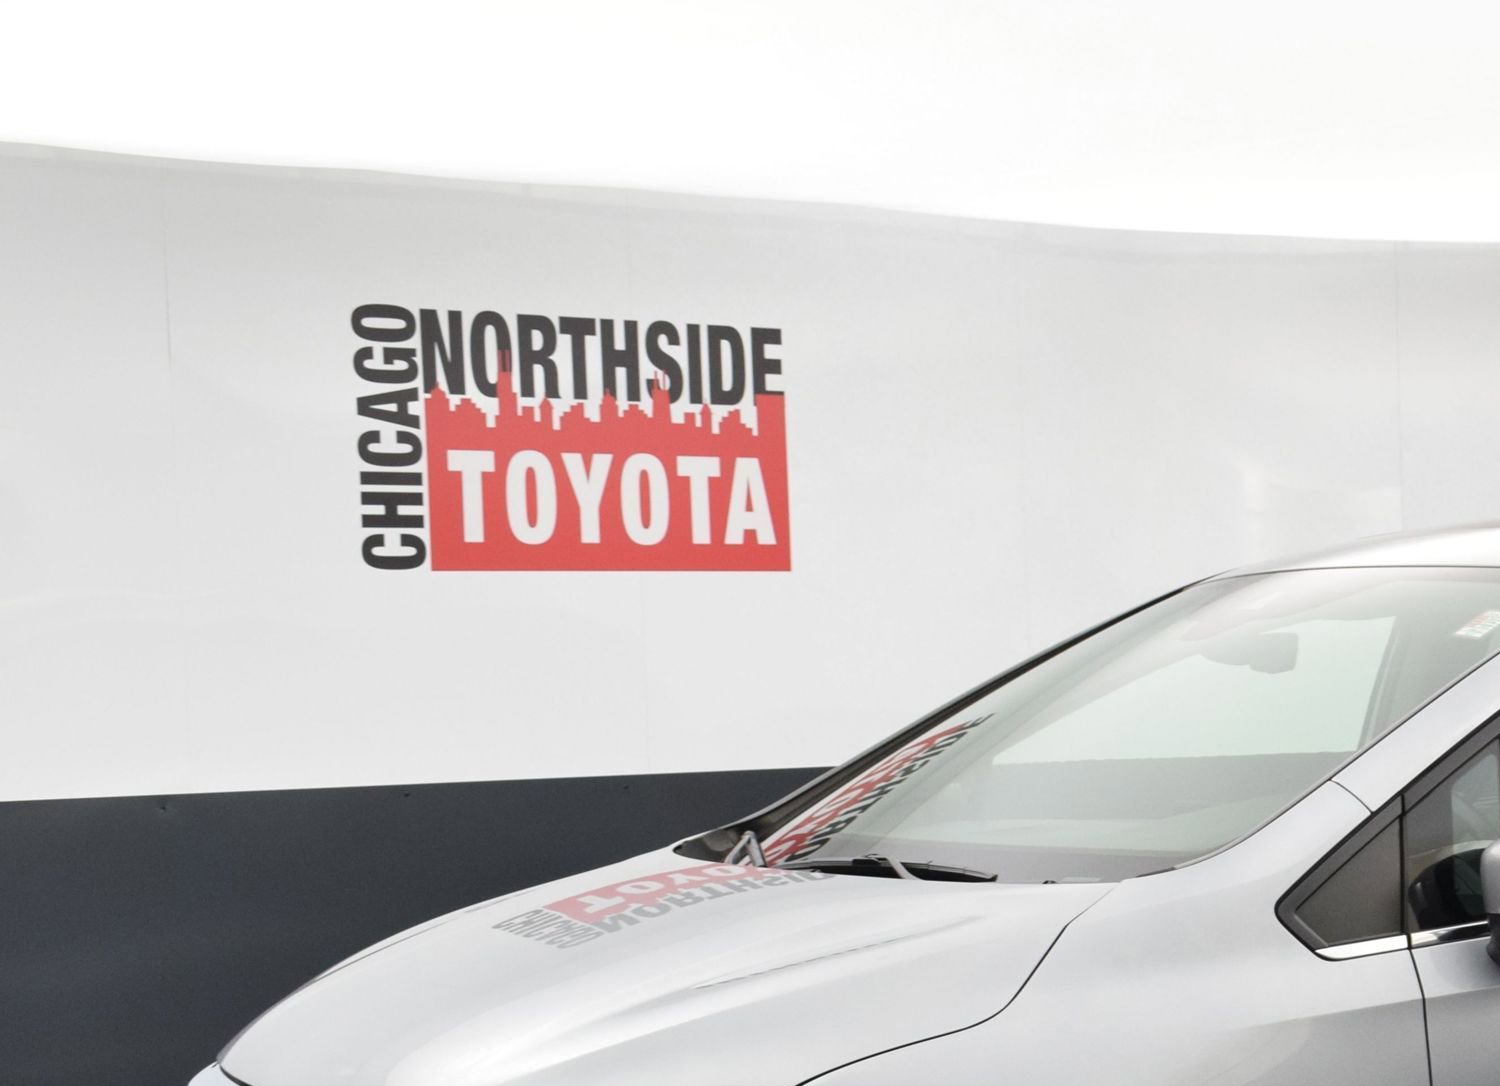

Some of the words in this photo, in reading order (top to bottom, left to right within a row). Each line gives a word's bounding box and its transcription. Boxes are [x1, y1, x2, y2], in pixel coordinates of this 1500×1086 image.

[418, 308, 785, 406] NORTHSIDE
[351, 303, 427, 570] CHICAGO
[446, 449, 777, 546] TOYOTA
